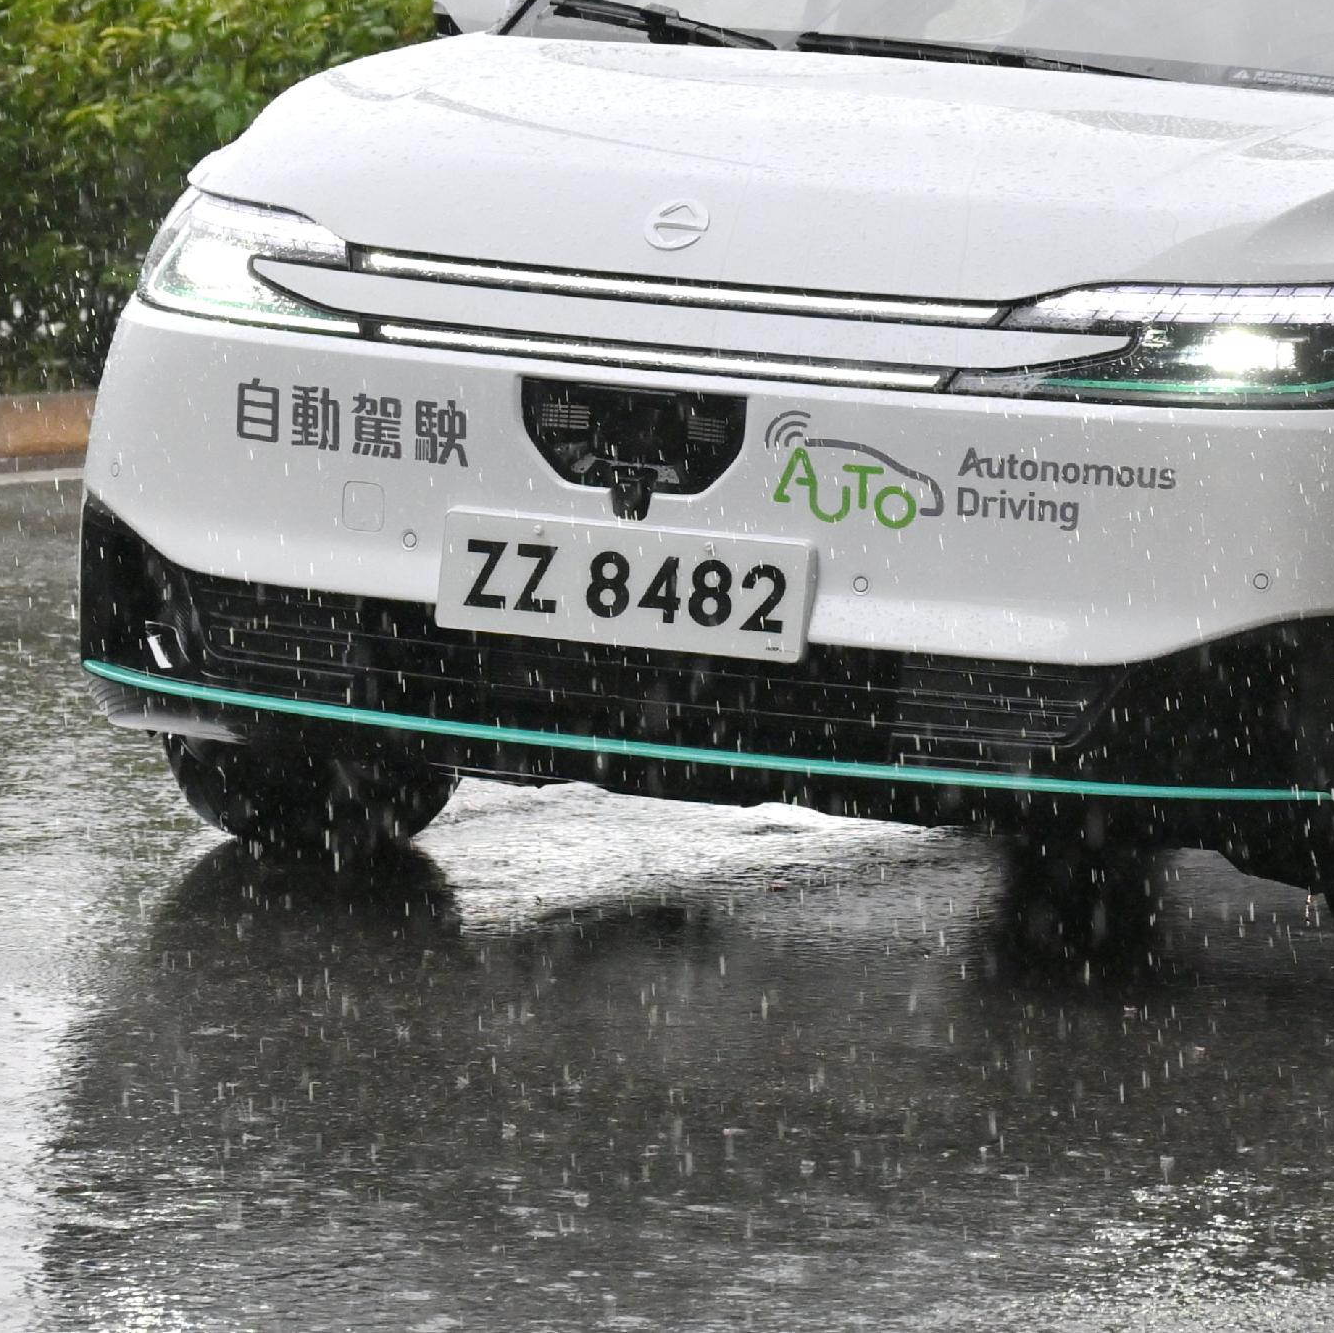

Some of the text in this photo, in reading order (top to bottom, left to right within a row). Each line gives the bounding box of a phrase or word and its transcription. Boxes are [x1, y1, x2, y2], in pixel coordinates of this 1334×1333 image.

[237, 378, 468, 467] 自動駕駛
[958, 447, 1177, 490] Autonomous
[957, 487, 1079, 531] Driving
[463, 539, 786, 633] ZZ 8482
